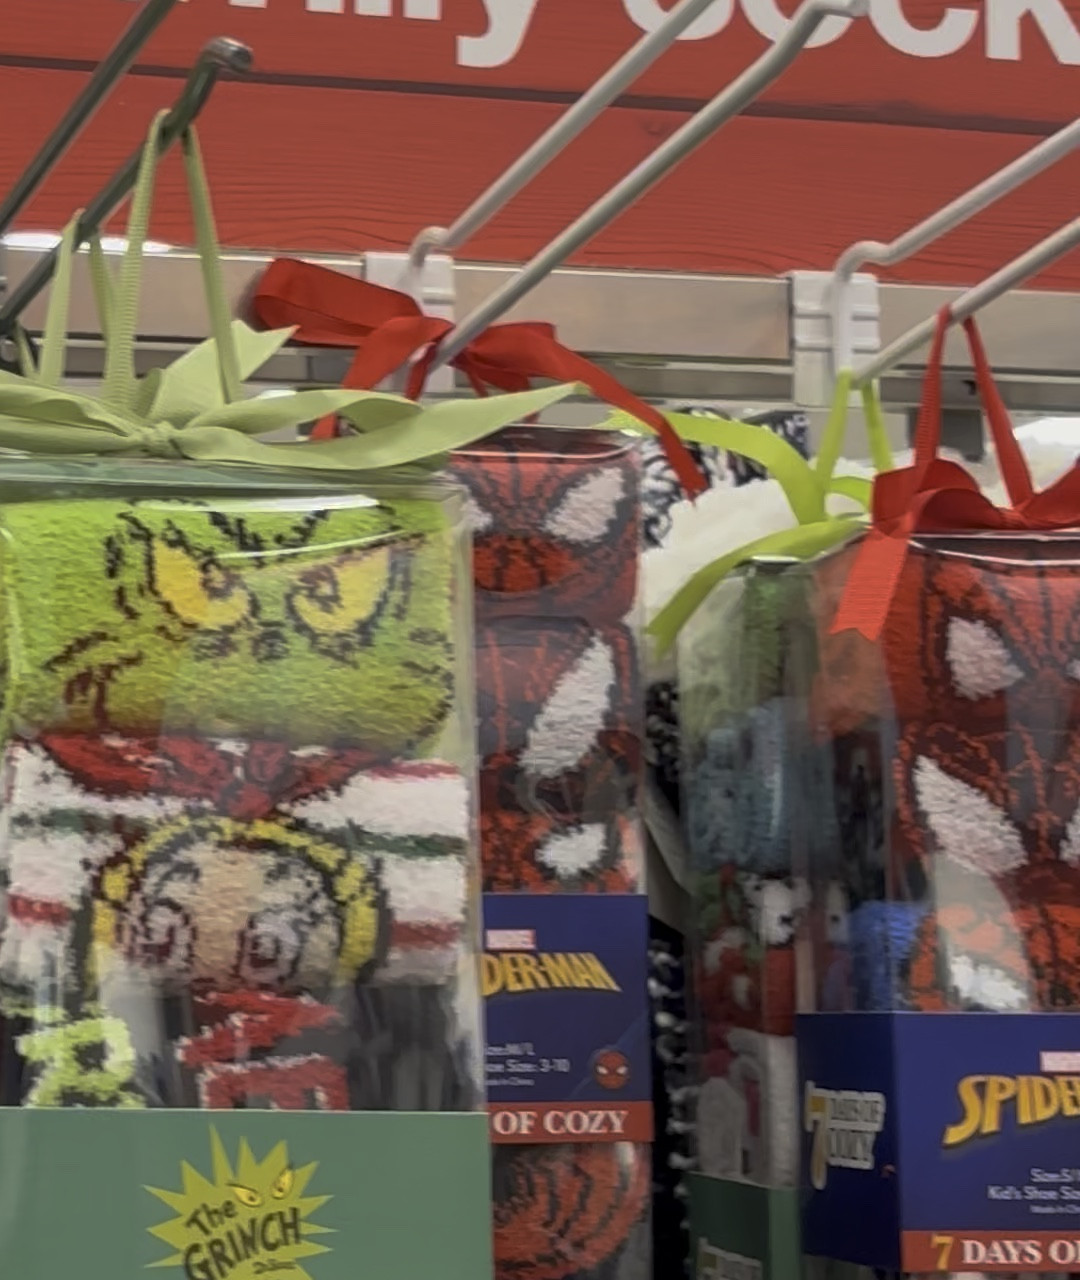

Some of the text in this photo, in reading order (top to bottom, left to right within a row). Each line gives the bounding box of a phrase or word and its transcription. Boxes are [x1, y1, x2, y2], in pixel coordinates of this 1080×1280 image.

[492, 1110, 629, 1135] OF COZY
[942, 1074, 1080, 1146] SPIDE
[185, 1200, 238, 1237] The
[930, 1233, 954, 1270] 7
[960, 1239, 1043, 1265] DAYS
